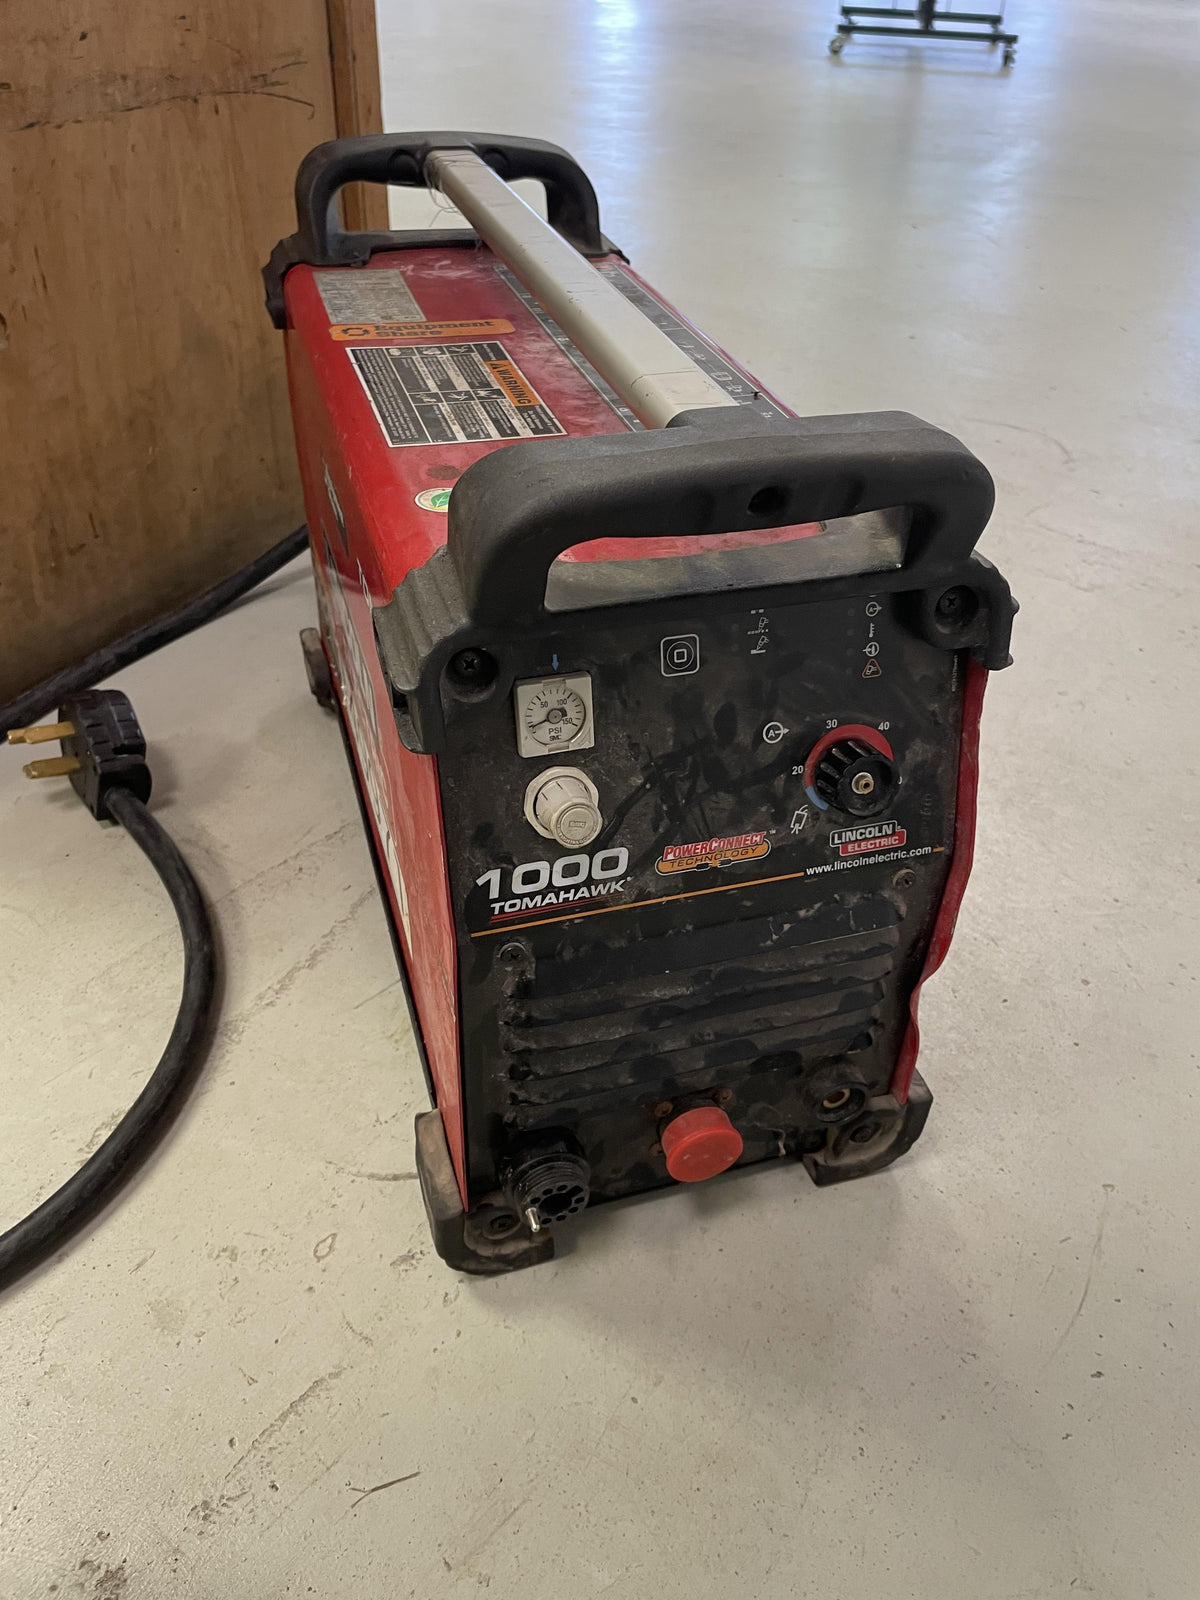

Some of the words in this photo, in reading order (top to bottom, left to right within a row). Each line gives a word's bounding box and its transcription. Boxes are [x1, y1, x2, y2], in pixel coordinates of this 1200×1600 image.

[375, 329, 442, 338] Share
[496, 368, 532, 405] WARNING
[548, 727, 562, 735] PSI
[826, 719, 838, 729] 30
[878, 722, 890, 731] 40
[792, 765, 804, 775] 20
[834, 823, 894, 844] LINCOLN
[847, 836, 899, 853] ELECTRIC
[670, 847, 758, 868] TECHNOLOGY
[806, 846, 932, 876] www.lincolnelectric.com
[475, 847, 629, 900] 1000
[490, 879, 626, 915] TOMAHAWK
